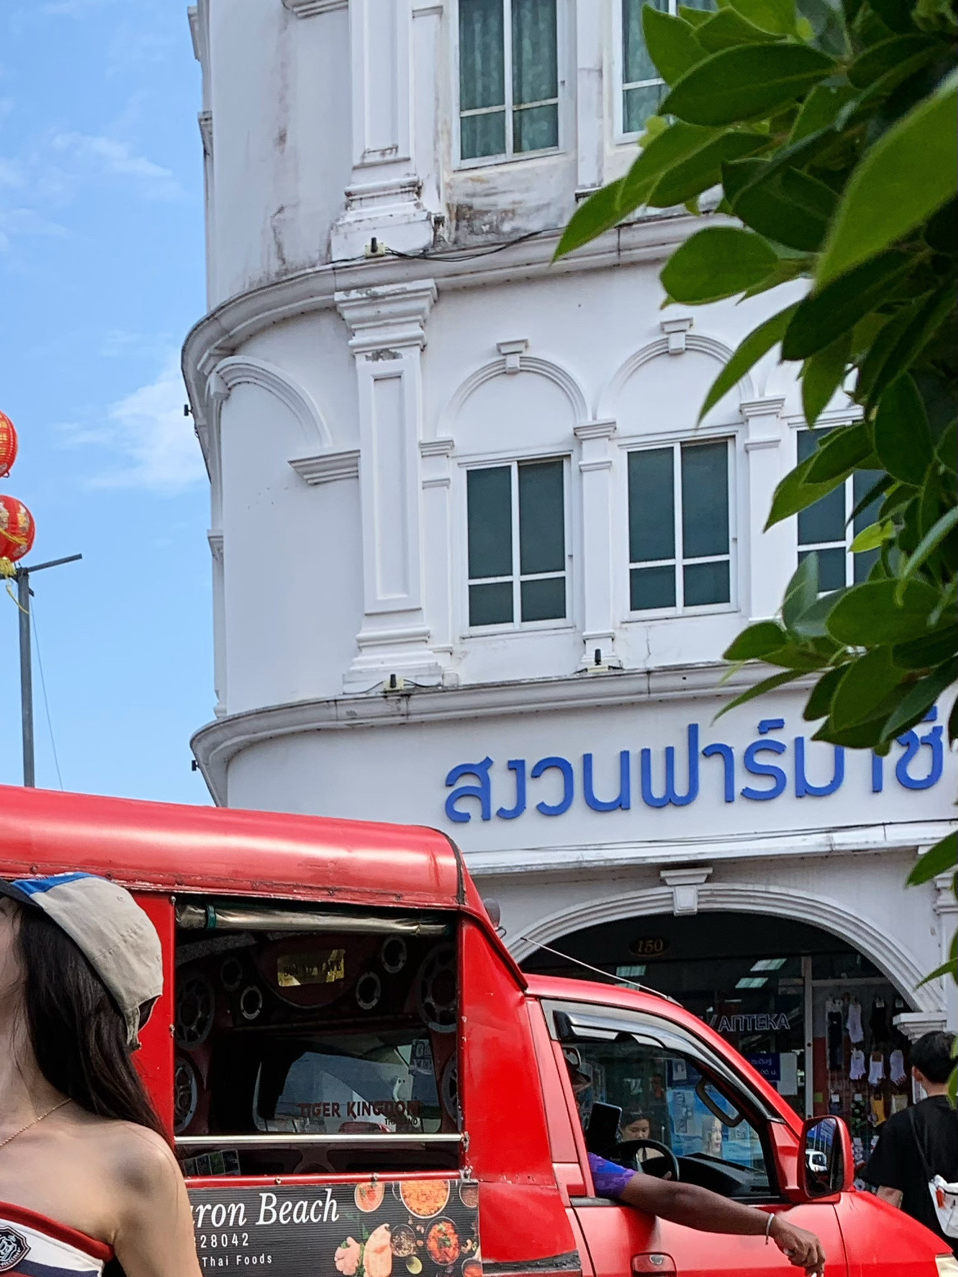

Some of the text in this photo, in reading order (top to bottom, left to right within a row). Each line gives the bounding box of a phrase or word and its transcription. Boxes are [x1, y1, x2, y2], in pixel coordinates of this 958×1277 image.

[444, 706, 944, 823] สงวนฟาร์มาซ
[637, 938, 664, 953] 150
[296, 1100, 423, 1120] TIGER KINGDOM
[190, 1188, 340, 1229] ron Beach
[195, 1232, 249, 1250] 28042
[202, 1253, 273, 1268] Thai Foods
